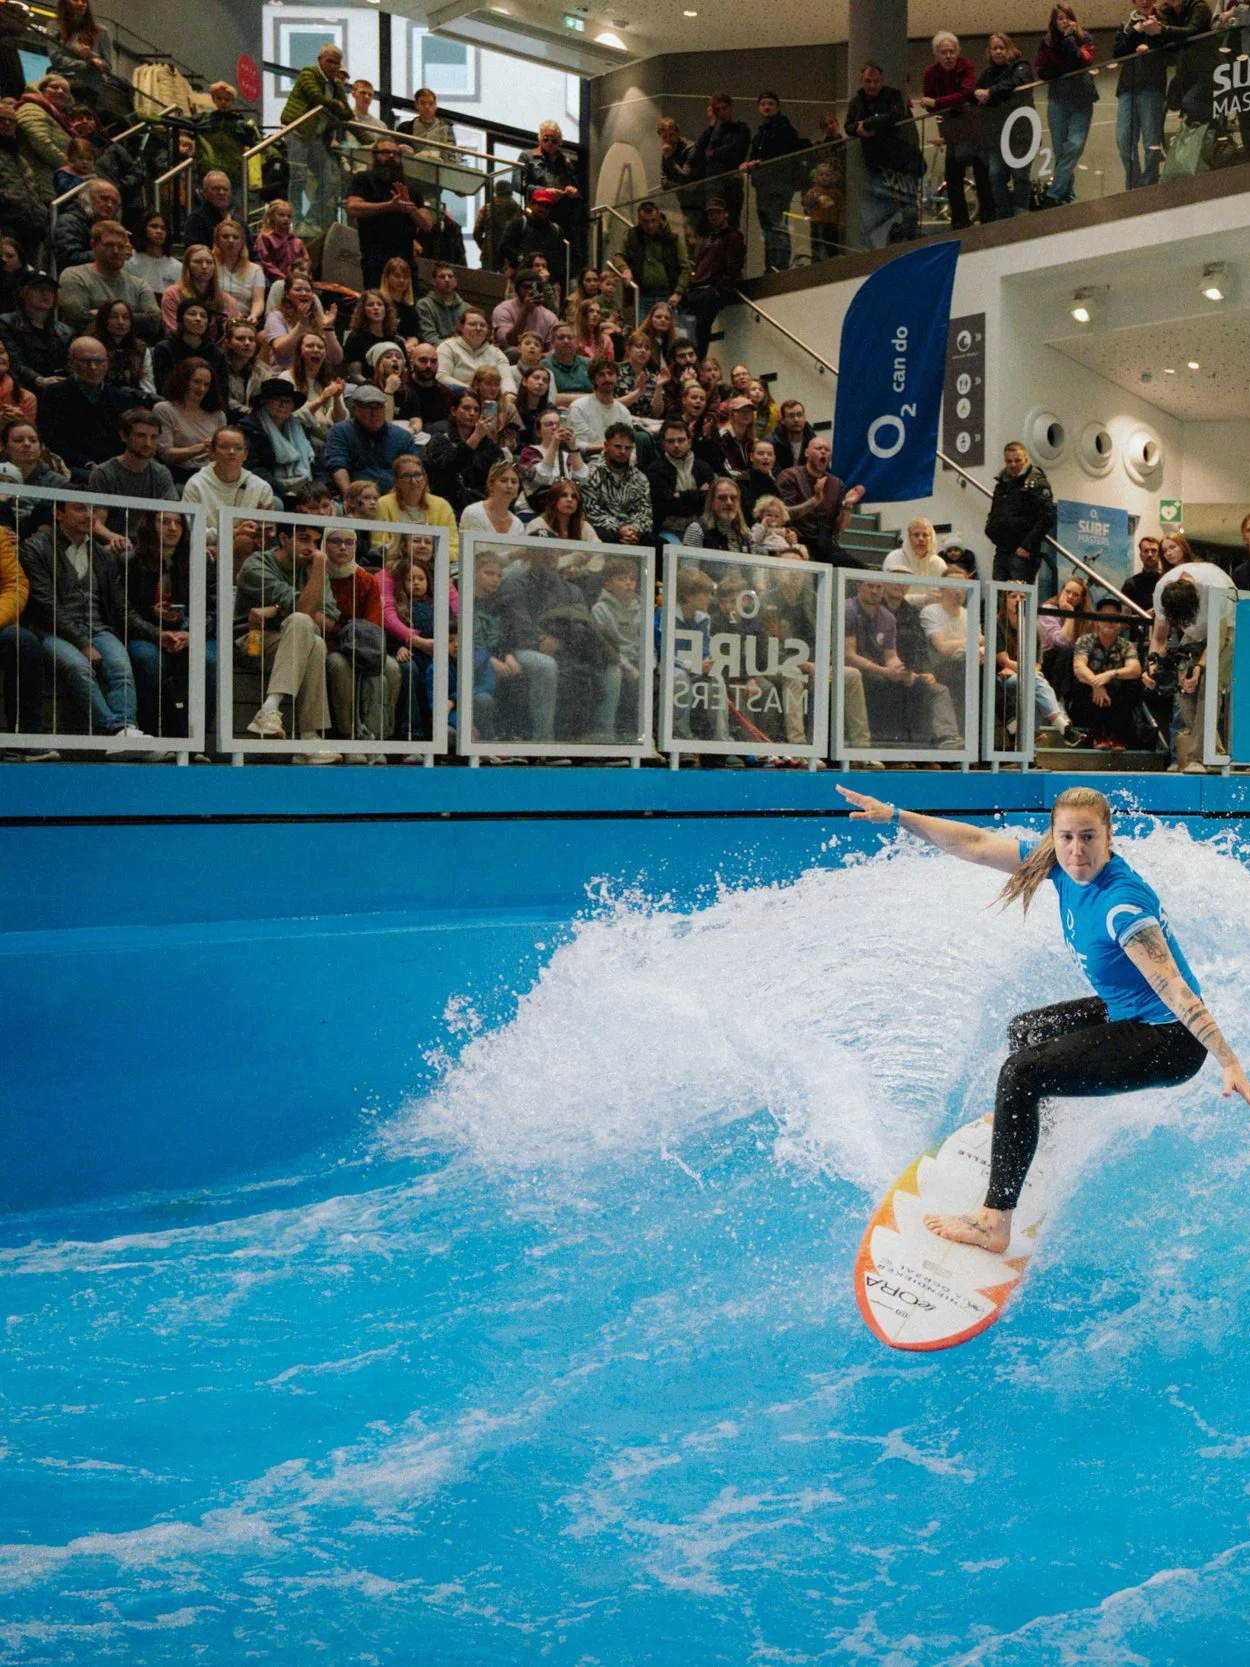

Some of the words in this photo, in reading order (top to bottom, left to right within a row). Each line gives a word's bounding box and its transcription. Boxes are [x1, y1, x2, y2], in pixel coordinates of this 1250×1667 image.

[1000, 106, 1053, 176] O2
[891, 325, 909, 352] do
[893, 357, 906, 393] can
[868, 402, 917, 459] O2
[1078, 520, 1110, 536] SURF
